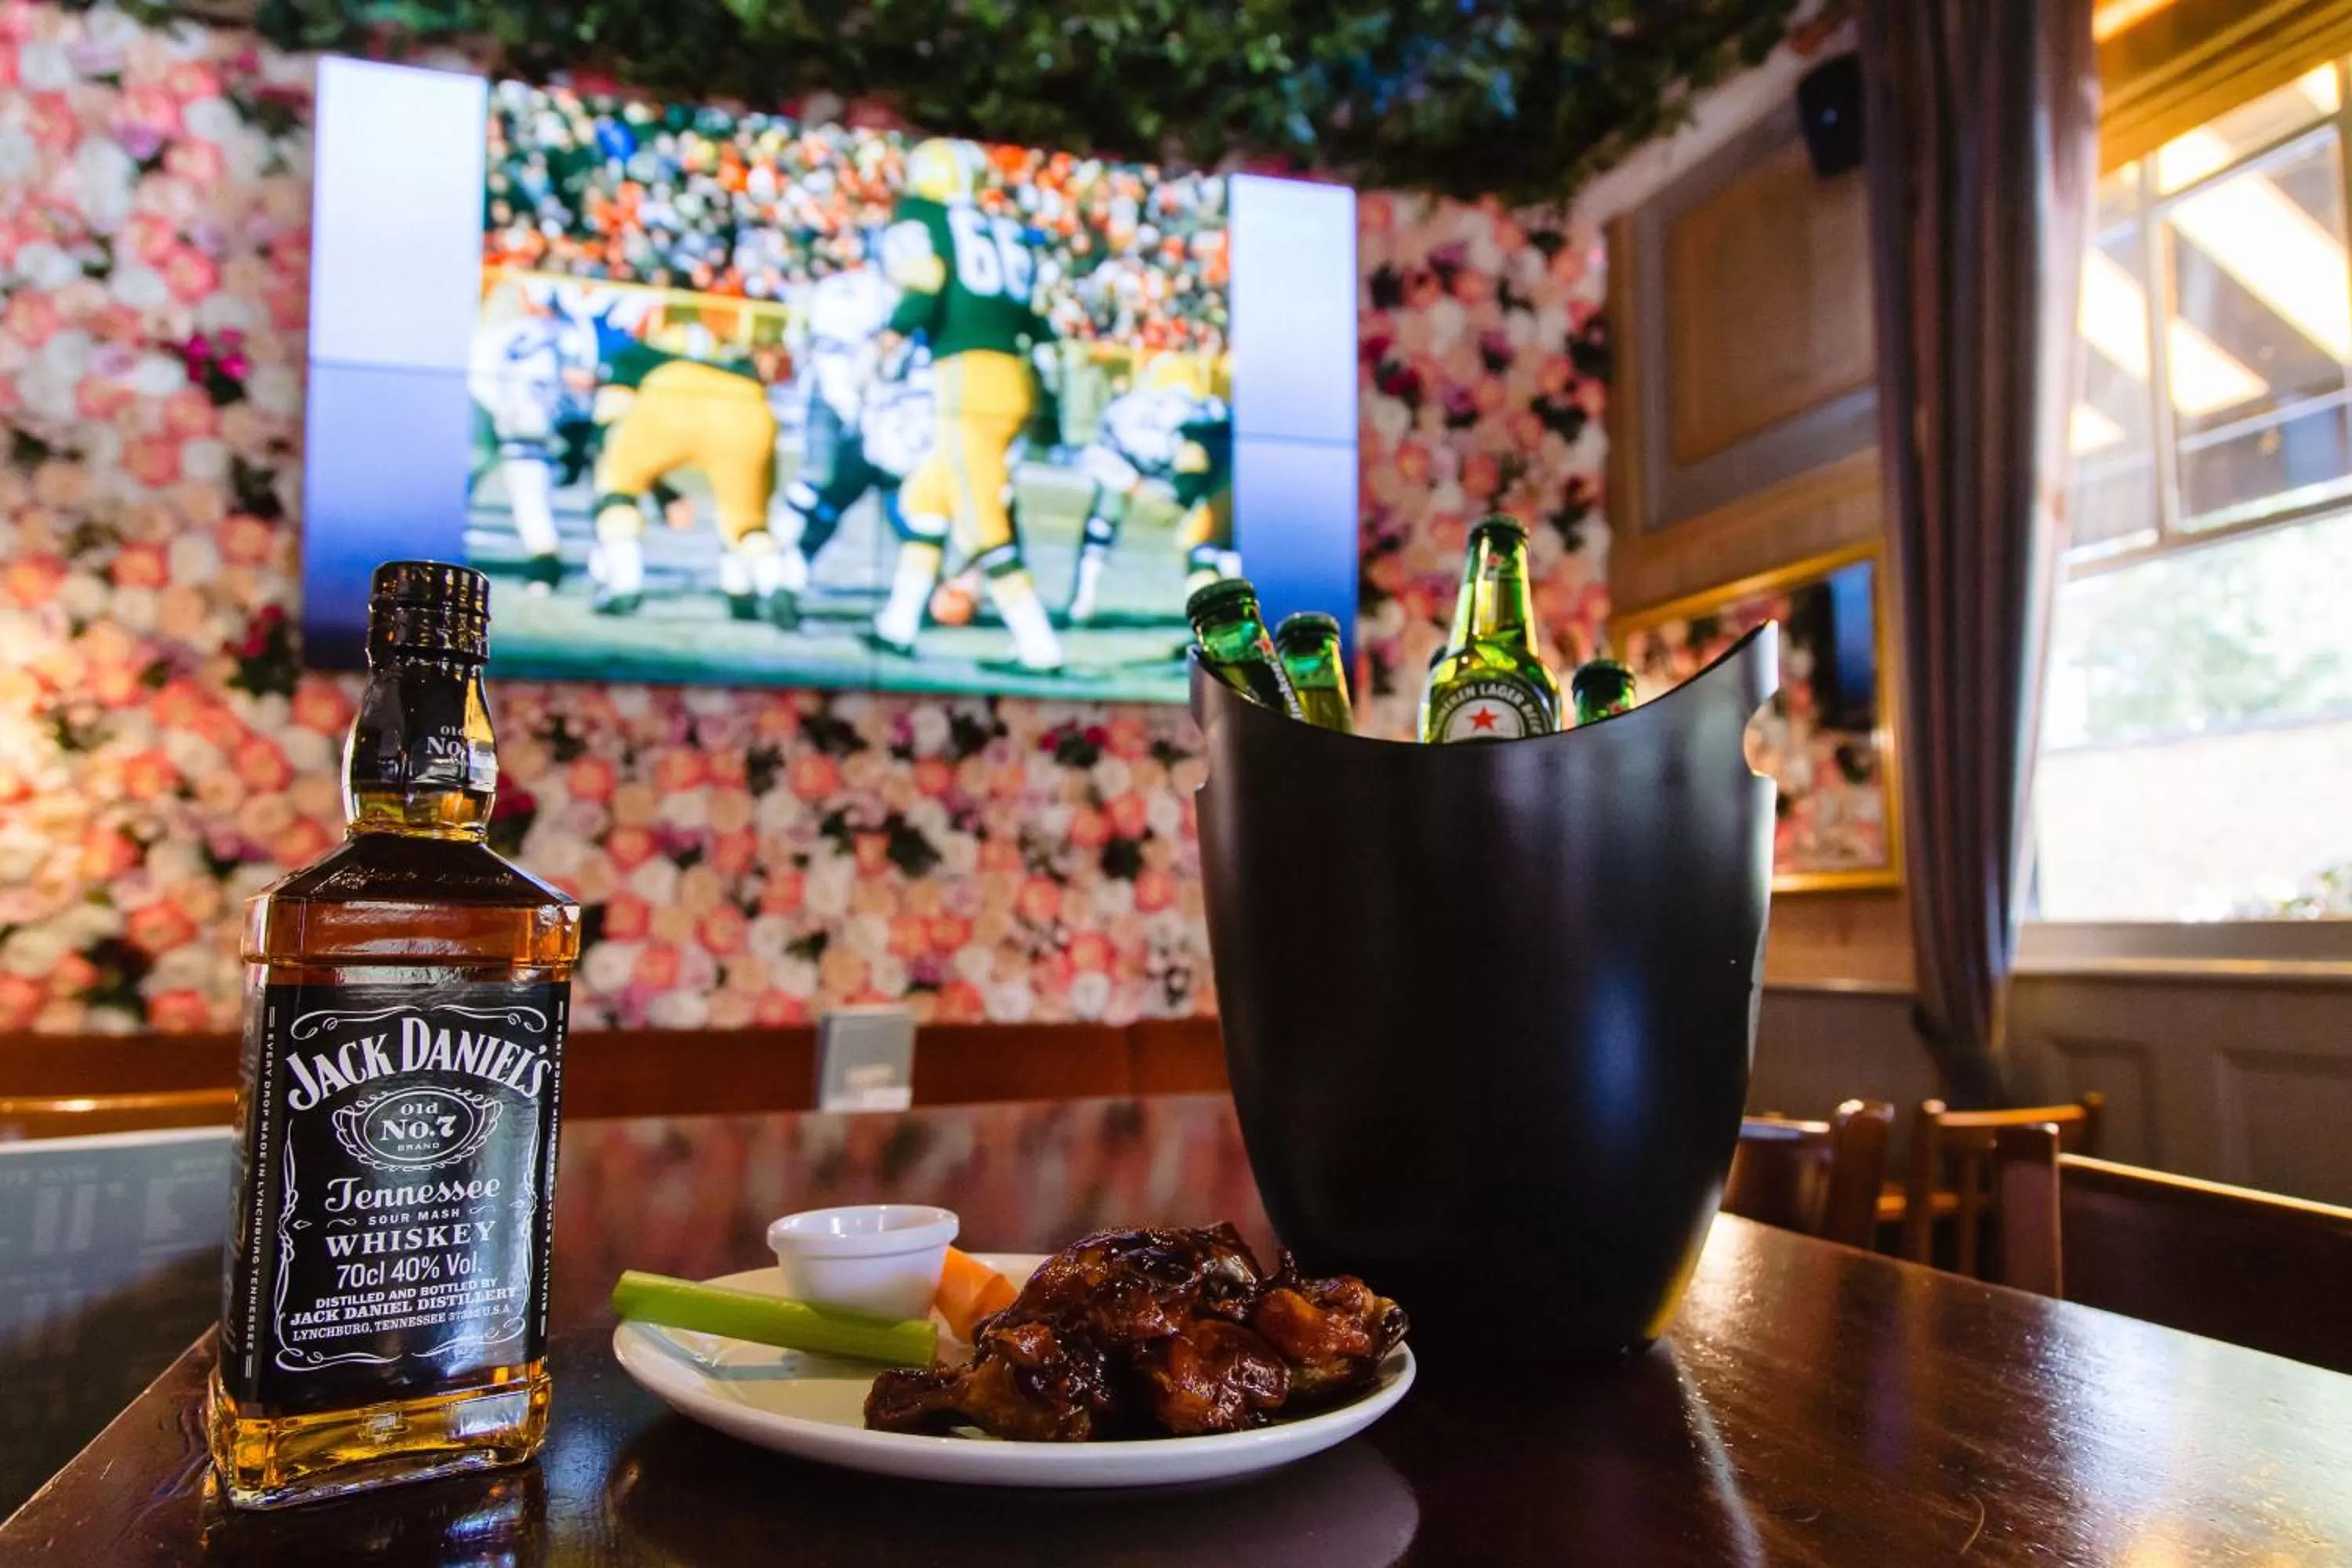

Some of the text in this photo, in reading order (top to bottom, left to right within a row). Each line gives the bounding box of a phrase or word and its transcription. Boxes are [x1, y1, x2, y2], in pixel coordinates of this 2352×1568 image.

[1479, 683, 1525, 707] LAGER
[285, 1016, 552, 1110] JACK DANIEL'S
[401, 1102, 439, 1116] Old
[379, 1115, 458, 1141] No.7
[397, 1143, 440, 1152] BRAND
[245, 1033, 274, 1350] EVERY DROP MADE IN LYNCHBURG TENNESSEE
[325, 1178, 500, 1212] Tennessee
[368, 1208, 460, 1225] SOUR MASH
[325, 1221, 497, 1258] WHISKEY
[336, 1250, 483, 1290] 70cl 40% Vol.
[289, 1287, 517, 1326] JACK DANIEL DISTILLERY
[315, 1277, 499, 1309] DISTILLED AND BOTTLED BY
[292, 1321, 373, 1341] LYNCHBURG,
[374, 1312, 446, 1331] TENNESSEE
